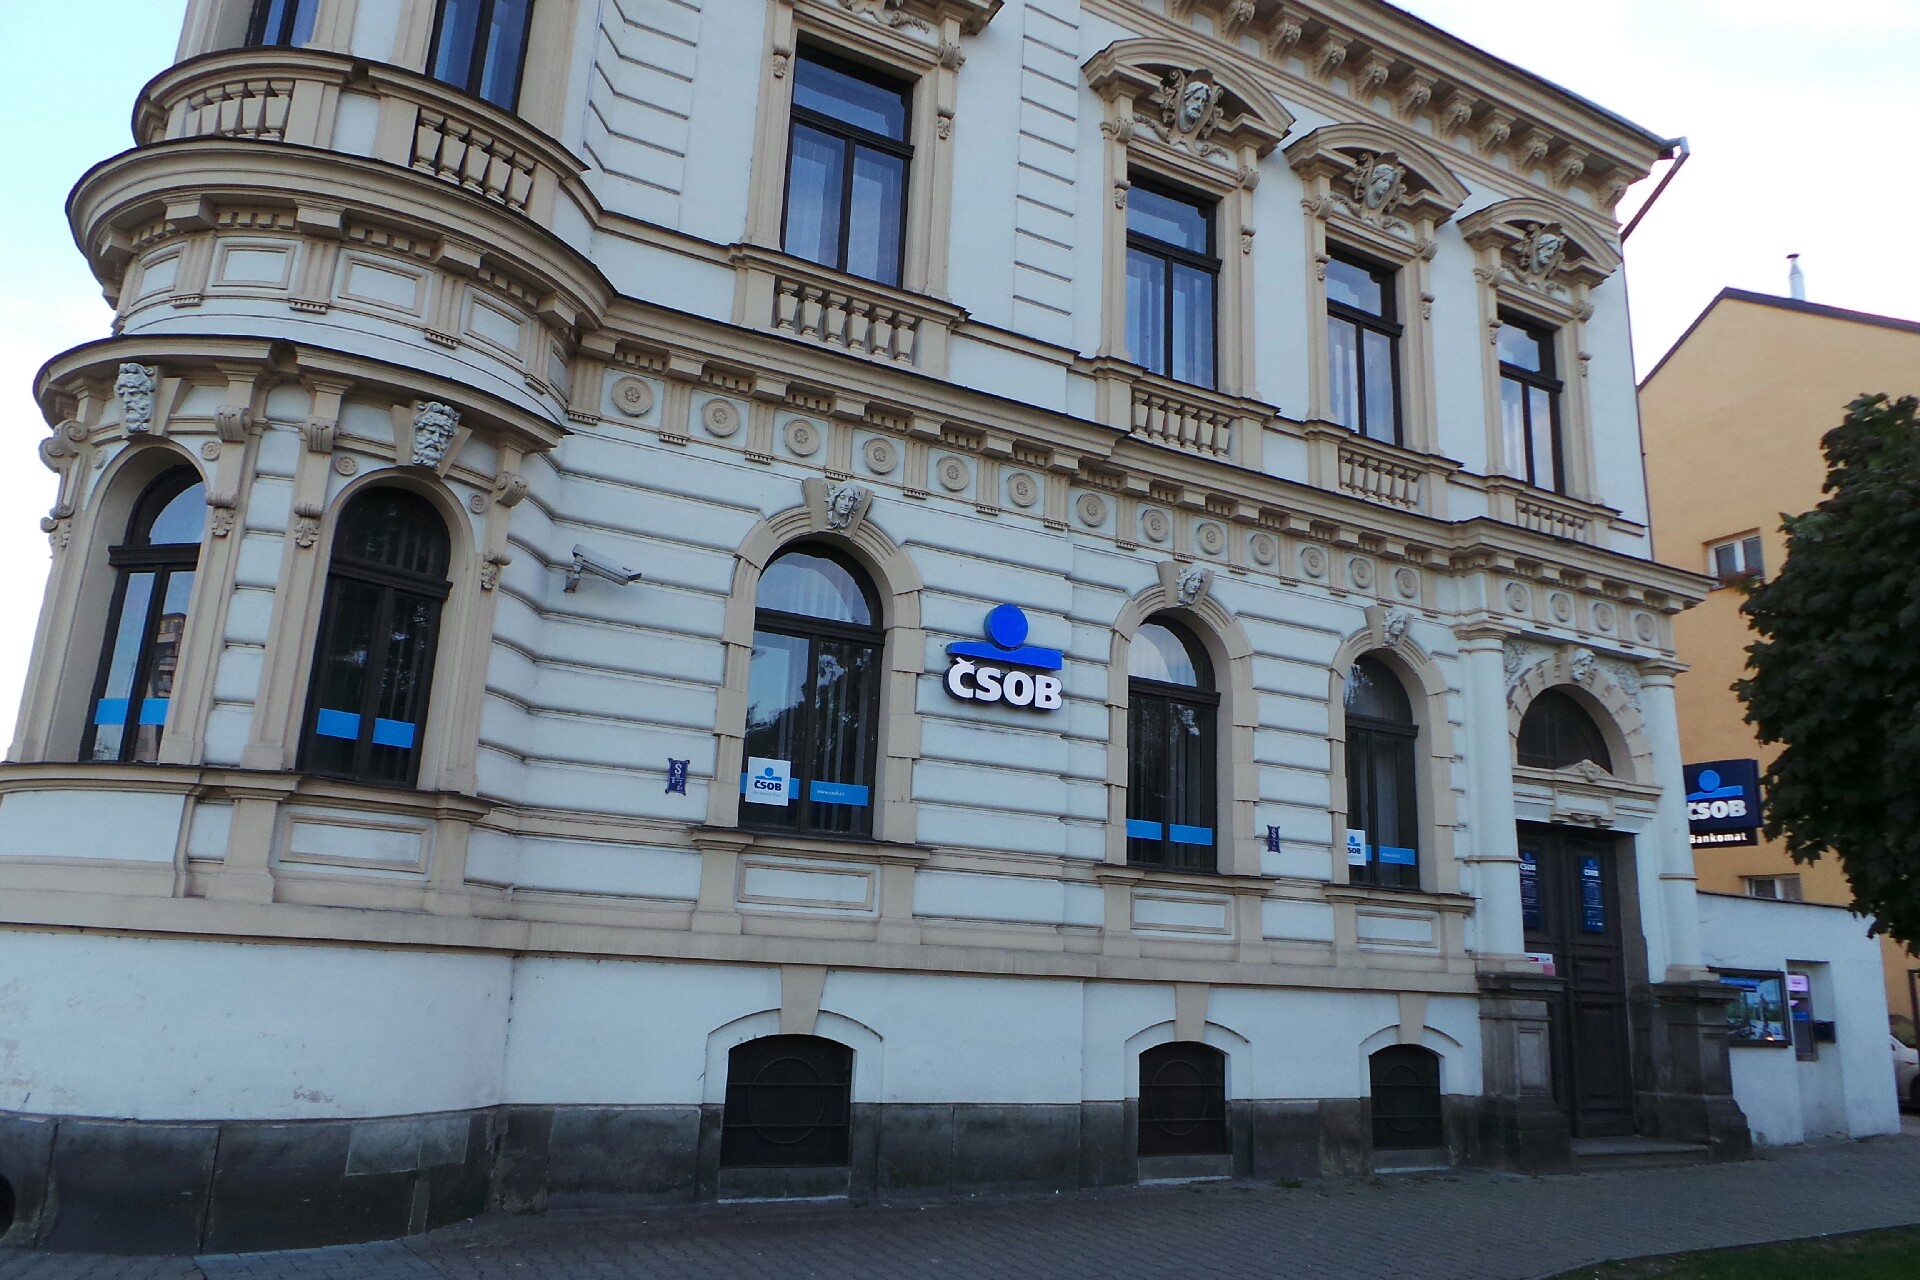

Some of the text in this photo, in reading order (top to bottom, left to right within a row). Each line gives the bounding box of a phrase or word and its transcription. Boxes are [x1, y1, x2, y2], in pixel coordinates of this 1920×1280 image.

[947, 657, 1063, 710] ČSOB
[754, 780, 782, 791] ČSOB
[1689, 832, 1747, 844] Bankomat
[1347, 847, 1361, 855] SOB
